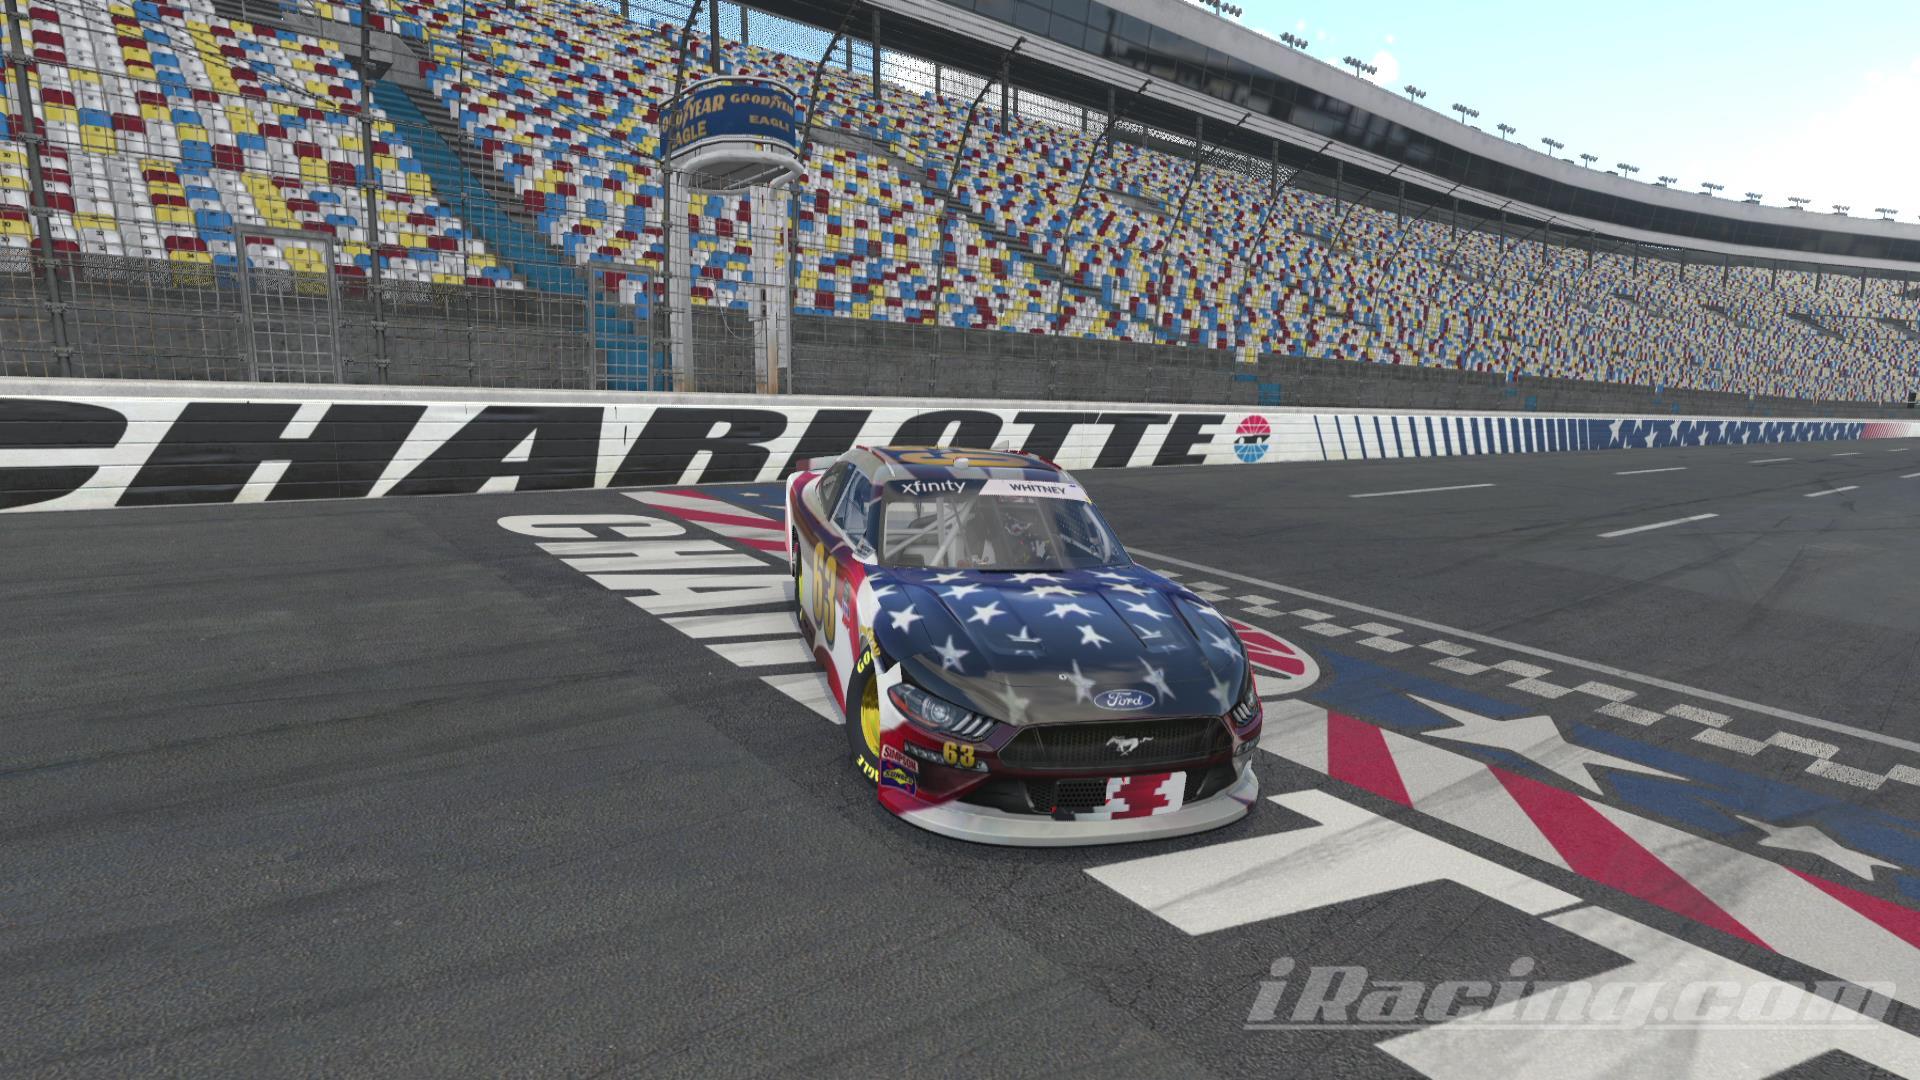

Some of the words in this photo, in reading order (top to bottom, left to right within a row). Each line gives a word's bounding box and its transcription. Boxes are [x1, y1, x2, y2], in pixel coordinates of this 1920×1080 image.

[660, 96, 726, 133] ODYEAR
[901, 479, 966, 495] xfinity
[1009, 483, 1066, 495] WHITNEY
[812, 541, 837, 651] 63
[883, 746, 917, 770] SIMPSON
[943, 741, 976, 768] 63
